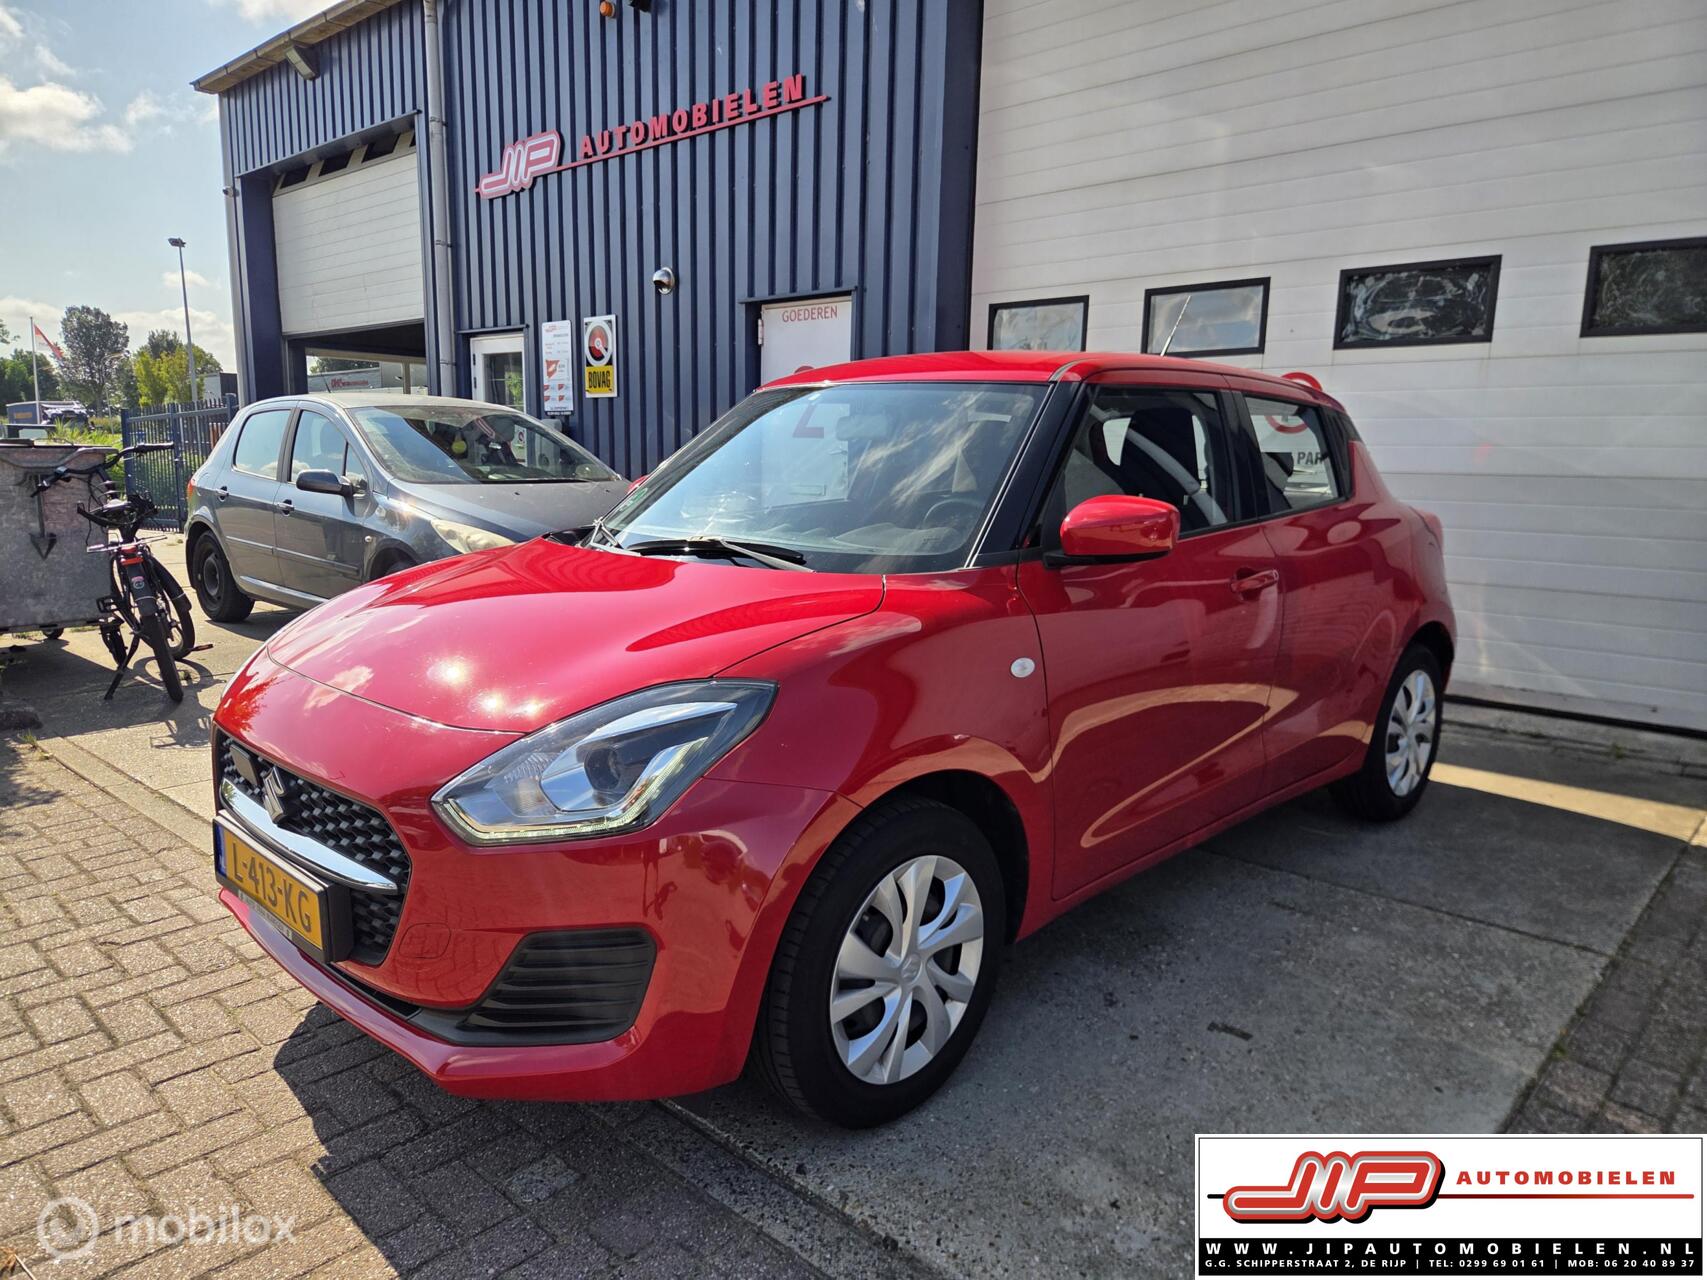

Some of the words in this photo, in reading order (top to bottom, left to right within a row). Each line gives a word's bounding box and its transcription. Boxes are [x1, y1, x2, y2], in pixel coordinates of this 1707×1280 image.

[479, 129, 561, 200] JIP
[579, 73, 804, 159] AUTOMOBIELEN
[781, 305, 838, 323] GOEDEREN
[588, 370, 611, 389] BOVAG
[232, 842, 312, 933] L-413-KG
